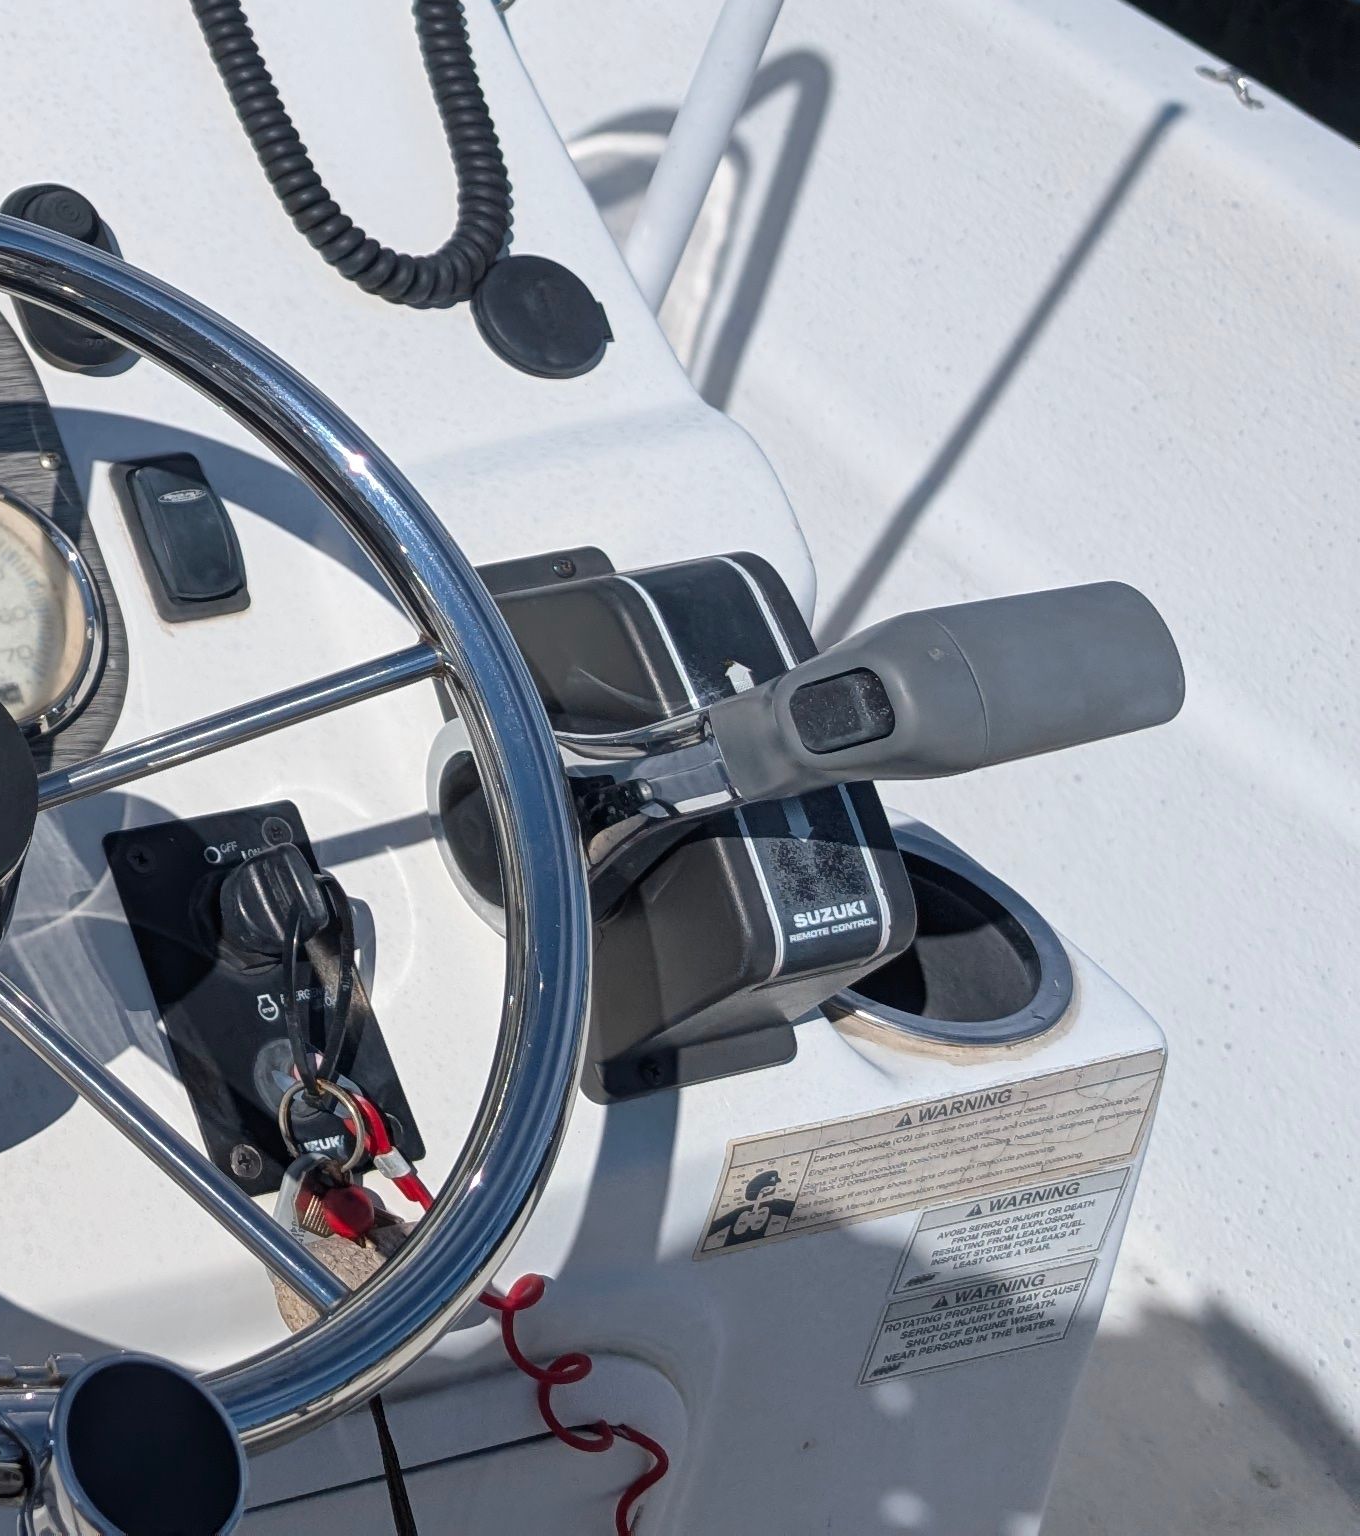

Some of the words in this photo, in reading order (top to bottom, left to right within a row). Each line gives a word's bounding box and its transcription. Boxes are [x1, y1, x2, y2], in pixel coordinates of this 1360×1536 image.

[220, 841, 237, 853] OFF
[789, 926, 830, 943] REMOTE
[830, 917, 878, 934] CONTROL
[793, 900, 868, 928] SUZUKI
[916, 1089, 1013, 1122] WARNING
[986, 1181, 1081, 1212] WARNING
[937, 1227, 966, 1238] AVOID
[968, 1218, 1010, 1232] SERIOUS
[1012, 1210, 1047, 1222] INJURY
[1047, 1205, 1062, 1216] OR
[1064, 1199, 1095, 1211] DEATH
[951, 1233, 978, 1244] FROM
[981, 1227, 1002, 1238] FIRE
[1004, 1223, 1017, 1233] OR
[1019, 1212, 1075, 1229] EXPLOSION
[931, 1252, 970, 1265] INSPECT
[973, 1243, 1010, 1255] SYSTEM
[1014, 1237, 1033, 1248] FOR
[1035, 1231, 1066, 1242] LEAKS
[1068, 1227, 1080, 1236] AT
[932, 1240, 984, 1257] RESULTING
[987, 1234, 1014, 1245] FROM
[1016, 1224, 1058, 1238] LEAKING
[953, 1258, 983, 1268] LEAST
[986, 1251, 1012, 1261] ONCE
[1013, 1248, 1022, 1256] A
[952, 1273, 1046, 1303] WARNING
[885, 1313, 941, 1331] ROTATING
[944, 1297, 1014, 1318] PROPELLER
[1015, 1292, 1039, 1303] MAY
[1042, 1283, 1081, 1297] CAUSE
[900, 1321, 951, 1338] SERIOUS
[953, 1312, 996, 1327] INJURY
[998, 1307, 1013, 1318] OR
[1016, 1299, 1057, 1313] DEATH.
[883, 1349, 915, 1362] NEAR
[917, 1336, 973, 1354] PERSONS
[975, 1332, 987, 1342] IN
[990, 1328, 1012, 1338] THE
[1015, 1318, 1057, 1333] WATER.
[905, 1335, 935, 1347] SHUT
[939, 1329, 962, 1340] OFF
[964, 1319, 1007, 1334] ENGINE
[1010, 1311, 1044, 1324] WHEN
